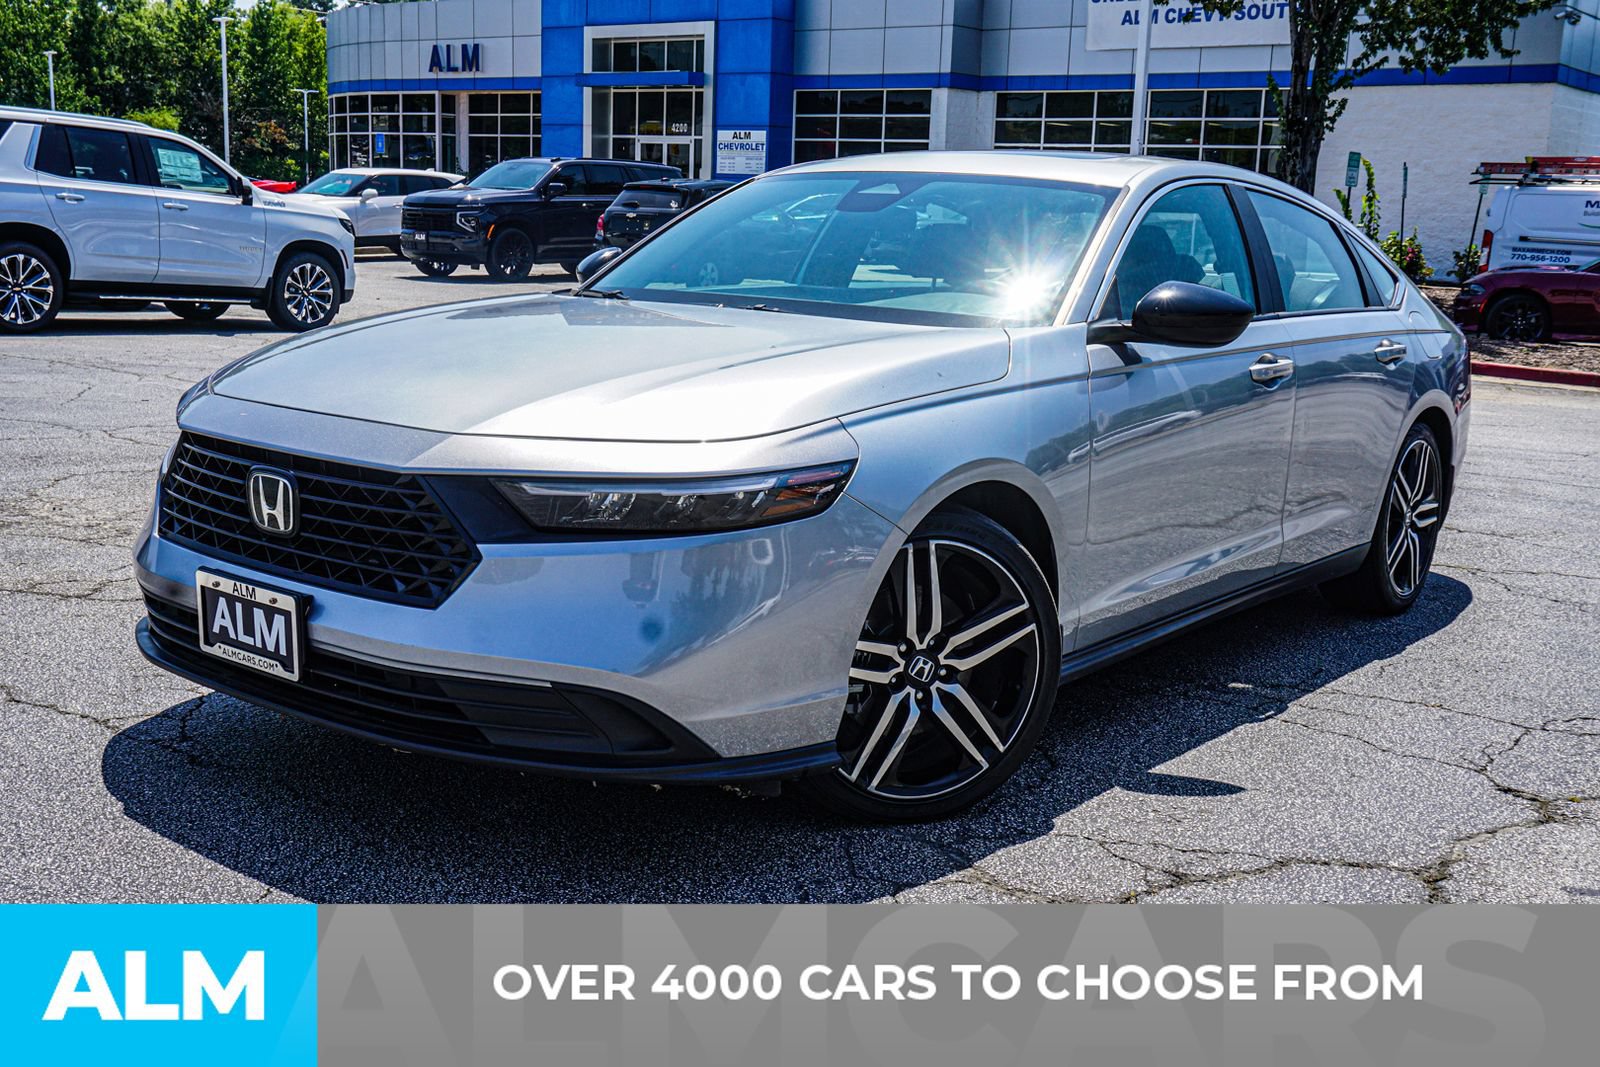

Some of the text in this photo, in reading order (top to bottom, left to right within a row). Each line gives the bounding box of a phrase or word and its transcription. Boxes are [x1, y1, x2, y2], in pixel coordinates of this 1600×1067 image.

[1234, 3, 1290, 20] SOUT
[428, 43, 480, 72] ALM
[671, 123, 688, 133] 4200
[732, 131, 752, 140] ALM
[718, 142, 765, 151] CHEVROLET
[1511, 253, 1571, 263] 770-956-1200
[232, 582, 257, 600] ALM
[212, 596, 287, 657] ALM
[222, 647, 275, 671] ALMCARS.COM
